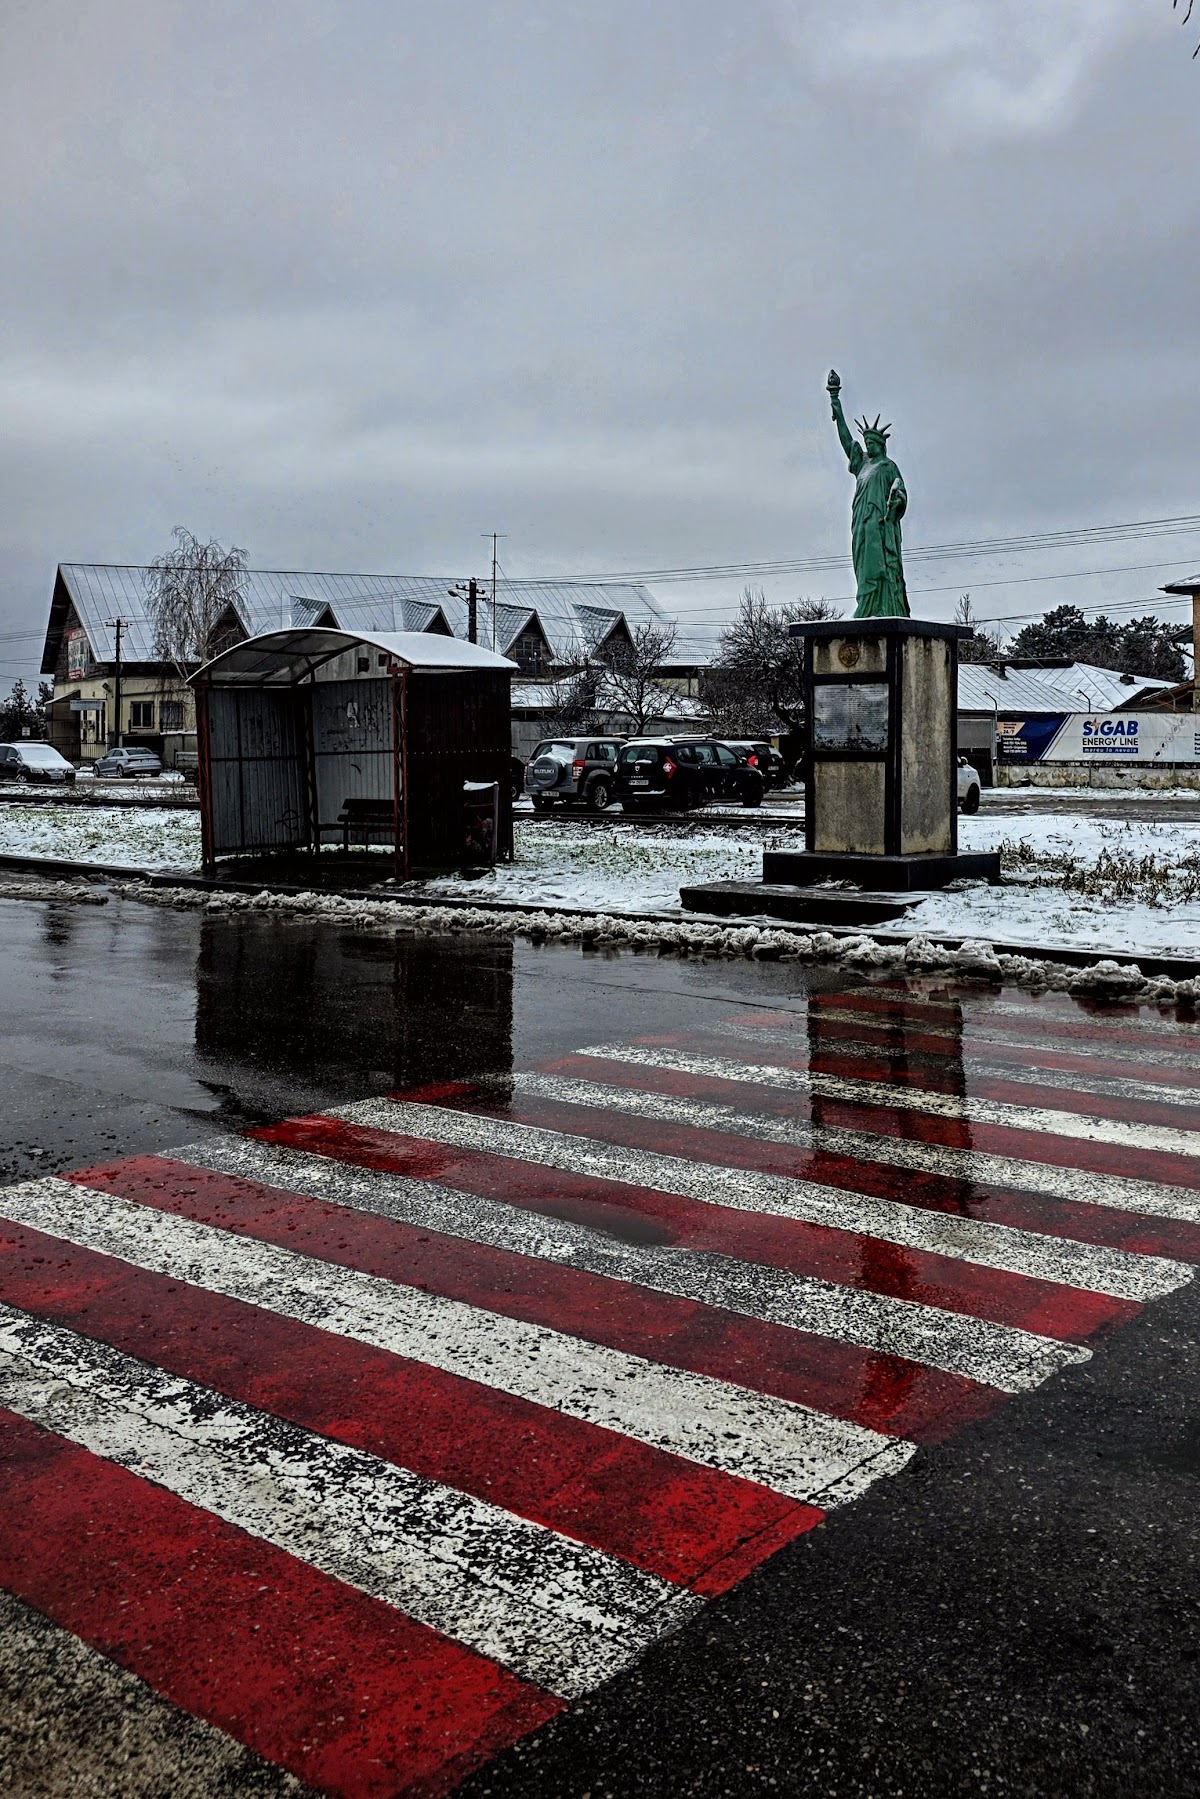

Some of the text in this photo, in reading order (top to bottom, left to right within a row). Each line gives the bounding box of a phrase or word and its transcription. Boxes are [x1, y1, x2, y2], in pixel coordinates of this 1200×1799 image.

[1083, 720, 1138, 736] SIGAB
[1083, 738, 1139, 746] ENERGY LINE
